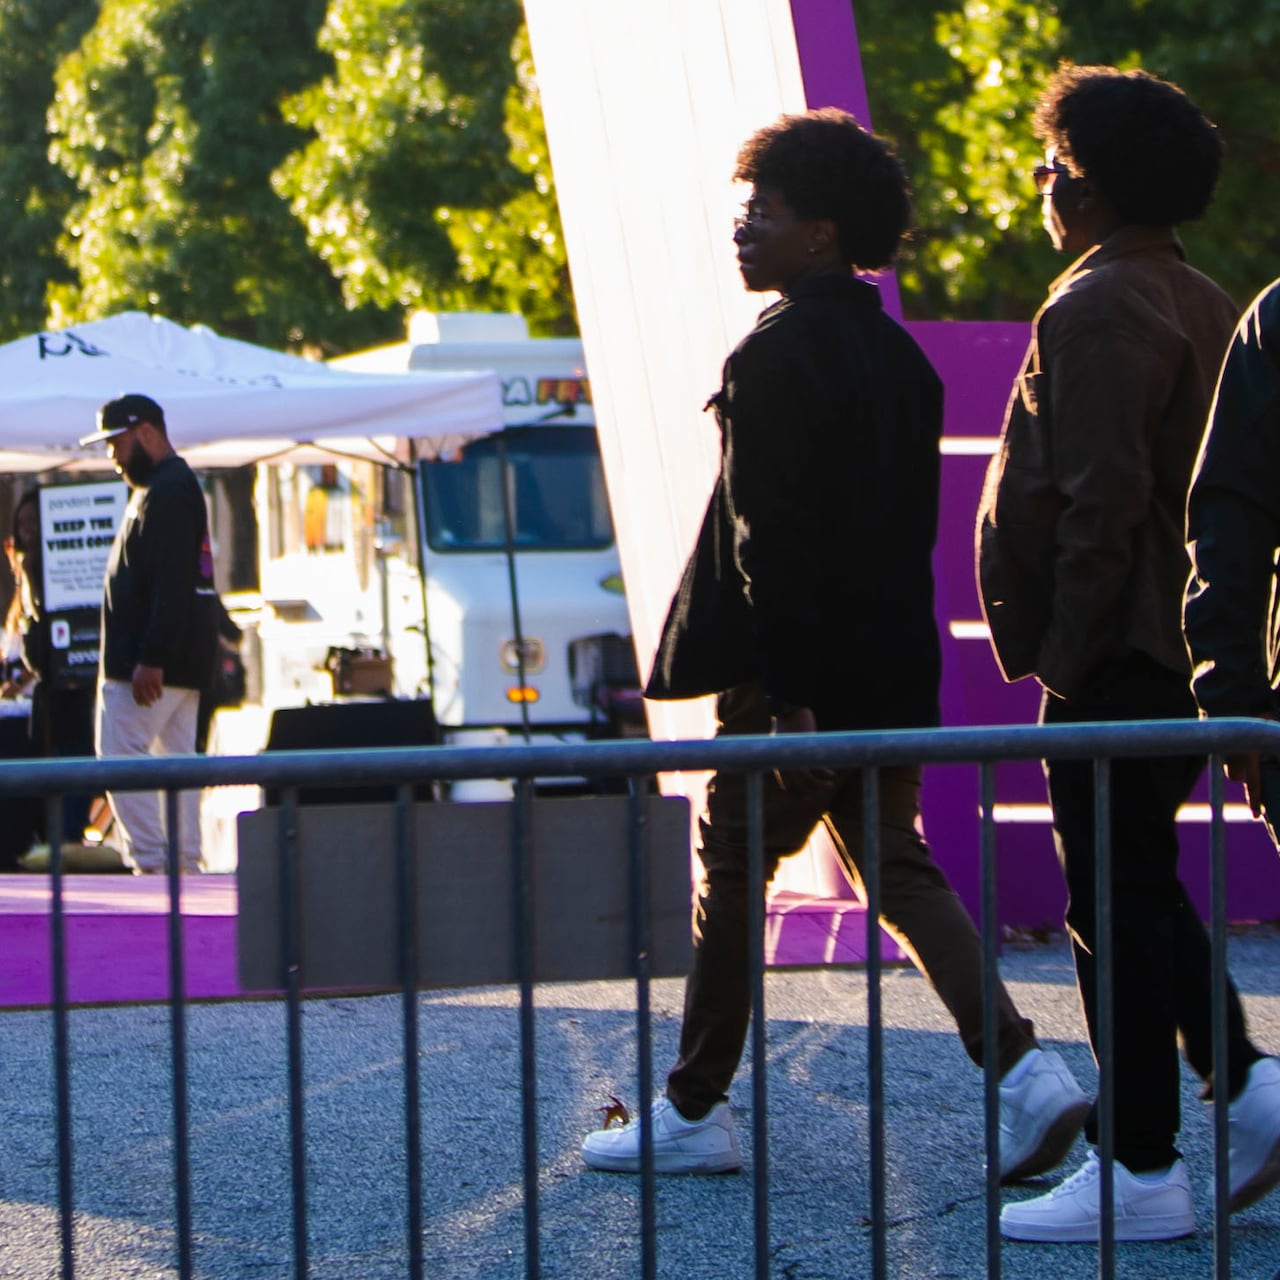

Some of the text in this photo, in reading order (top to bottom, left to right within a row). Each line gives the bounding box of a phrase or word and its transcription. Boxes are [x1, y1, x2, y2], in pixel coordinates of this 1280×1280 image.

[53, 516, 113, 534] KEEP THE
[46, 537, 84, 552] VIBES
